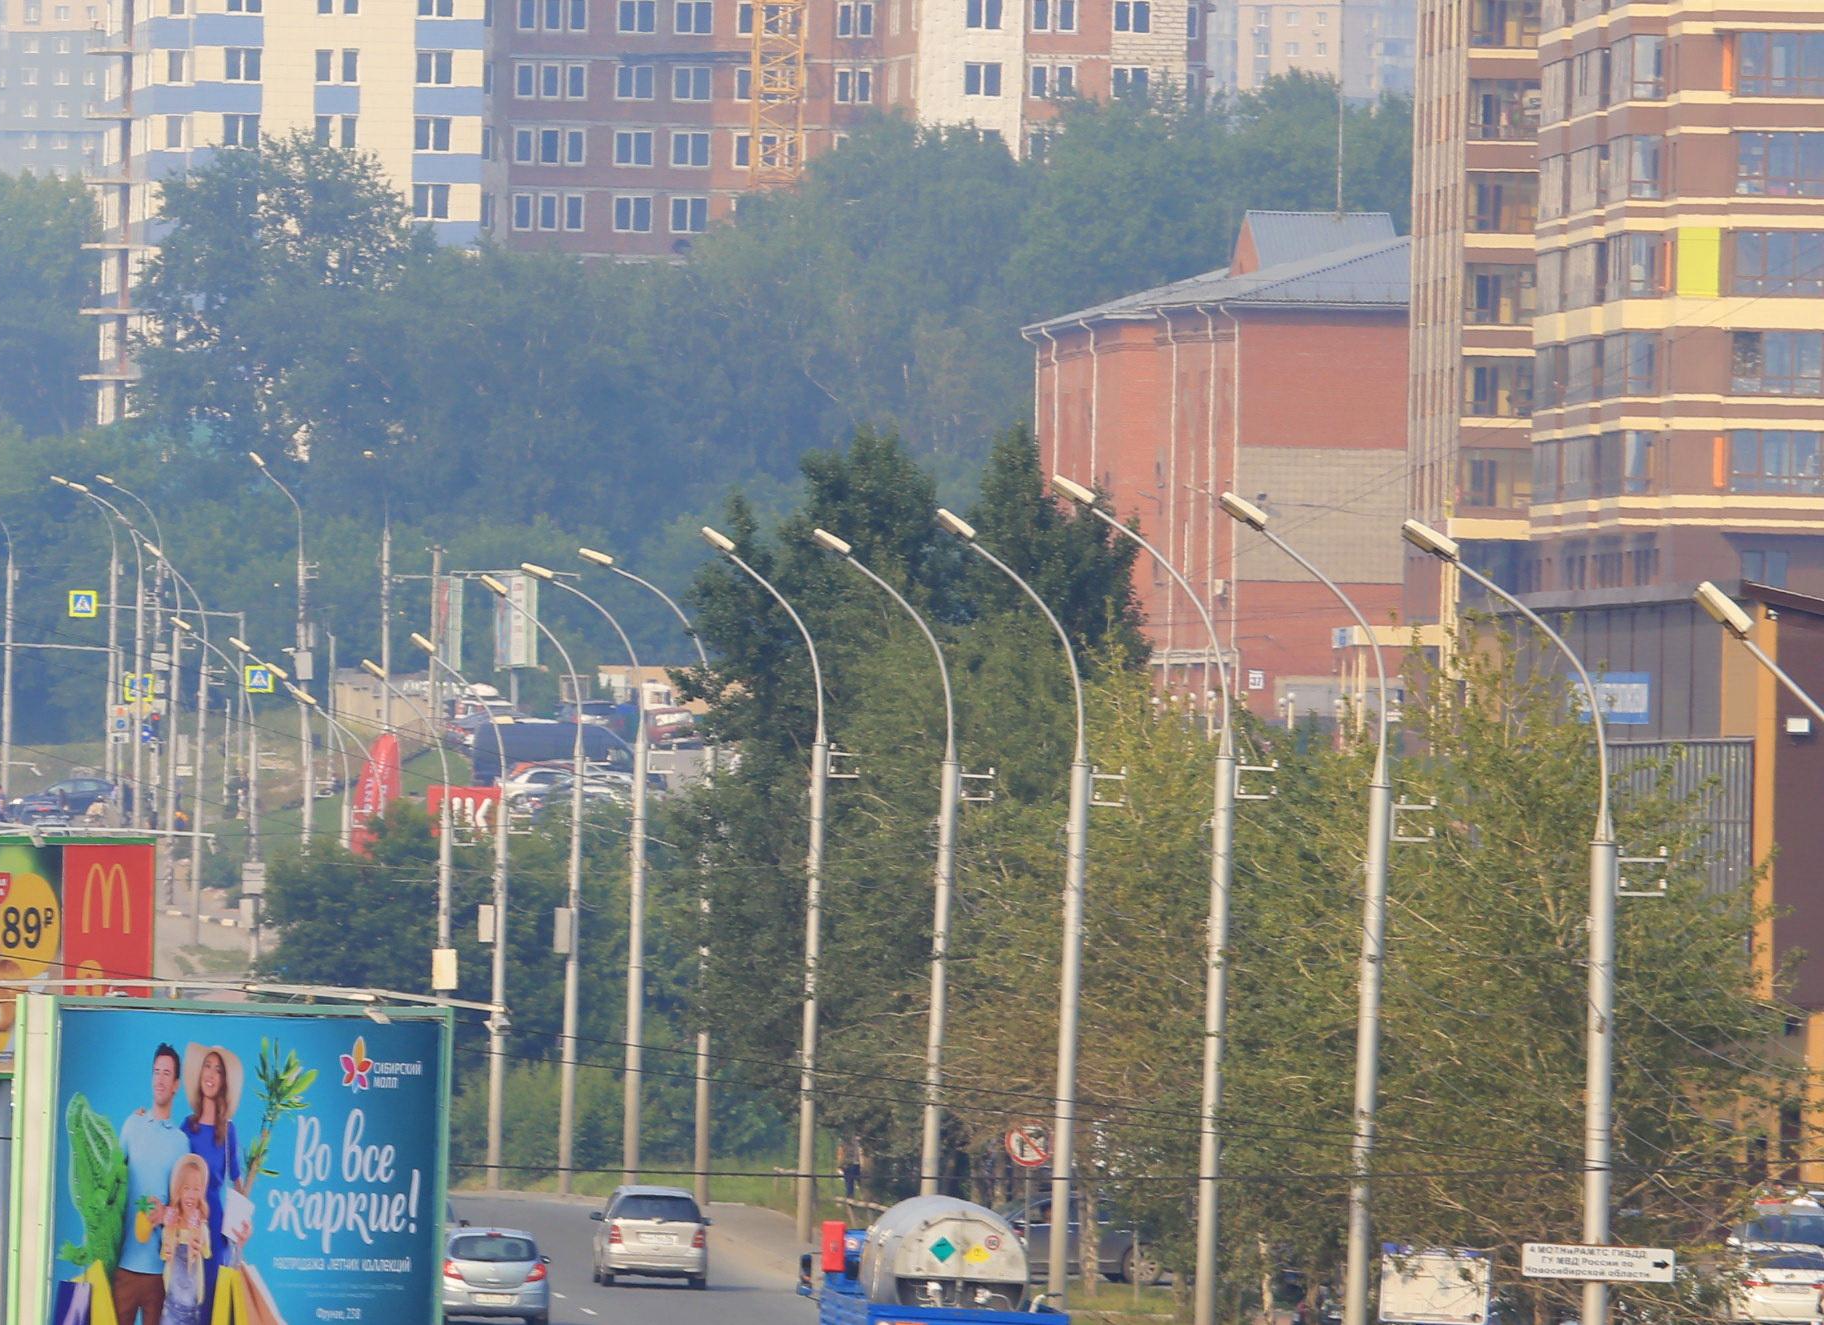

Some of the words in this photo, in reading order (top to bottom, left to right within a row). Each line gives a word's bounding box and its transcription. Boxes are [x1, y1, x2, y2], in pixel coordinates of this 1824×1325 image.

[373, 1060, 423, 1075] СИБИРСКИЙ
[373, 1076, 398, 1089] МОЛЛ
[293, 1114, 332, 1187] Во
[341, 1108, 395, 1183] все
[266, 1168, 421, 1254] жаркие!
[1611, 1249, 1647, 1259] ГИБДД
[1556, 1256, 1579, 1265] МВД
[1581, 1257, 1619, 1266] России
[1525, 1266, 1605, 1278] Новосибирской
[1607, 1269, 1651, 1279] области
